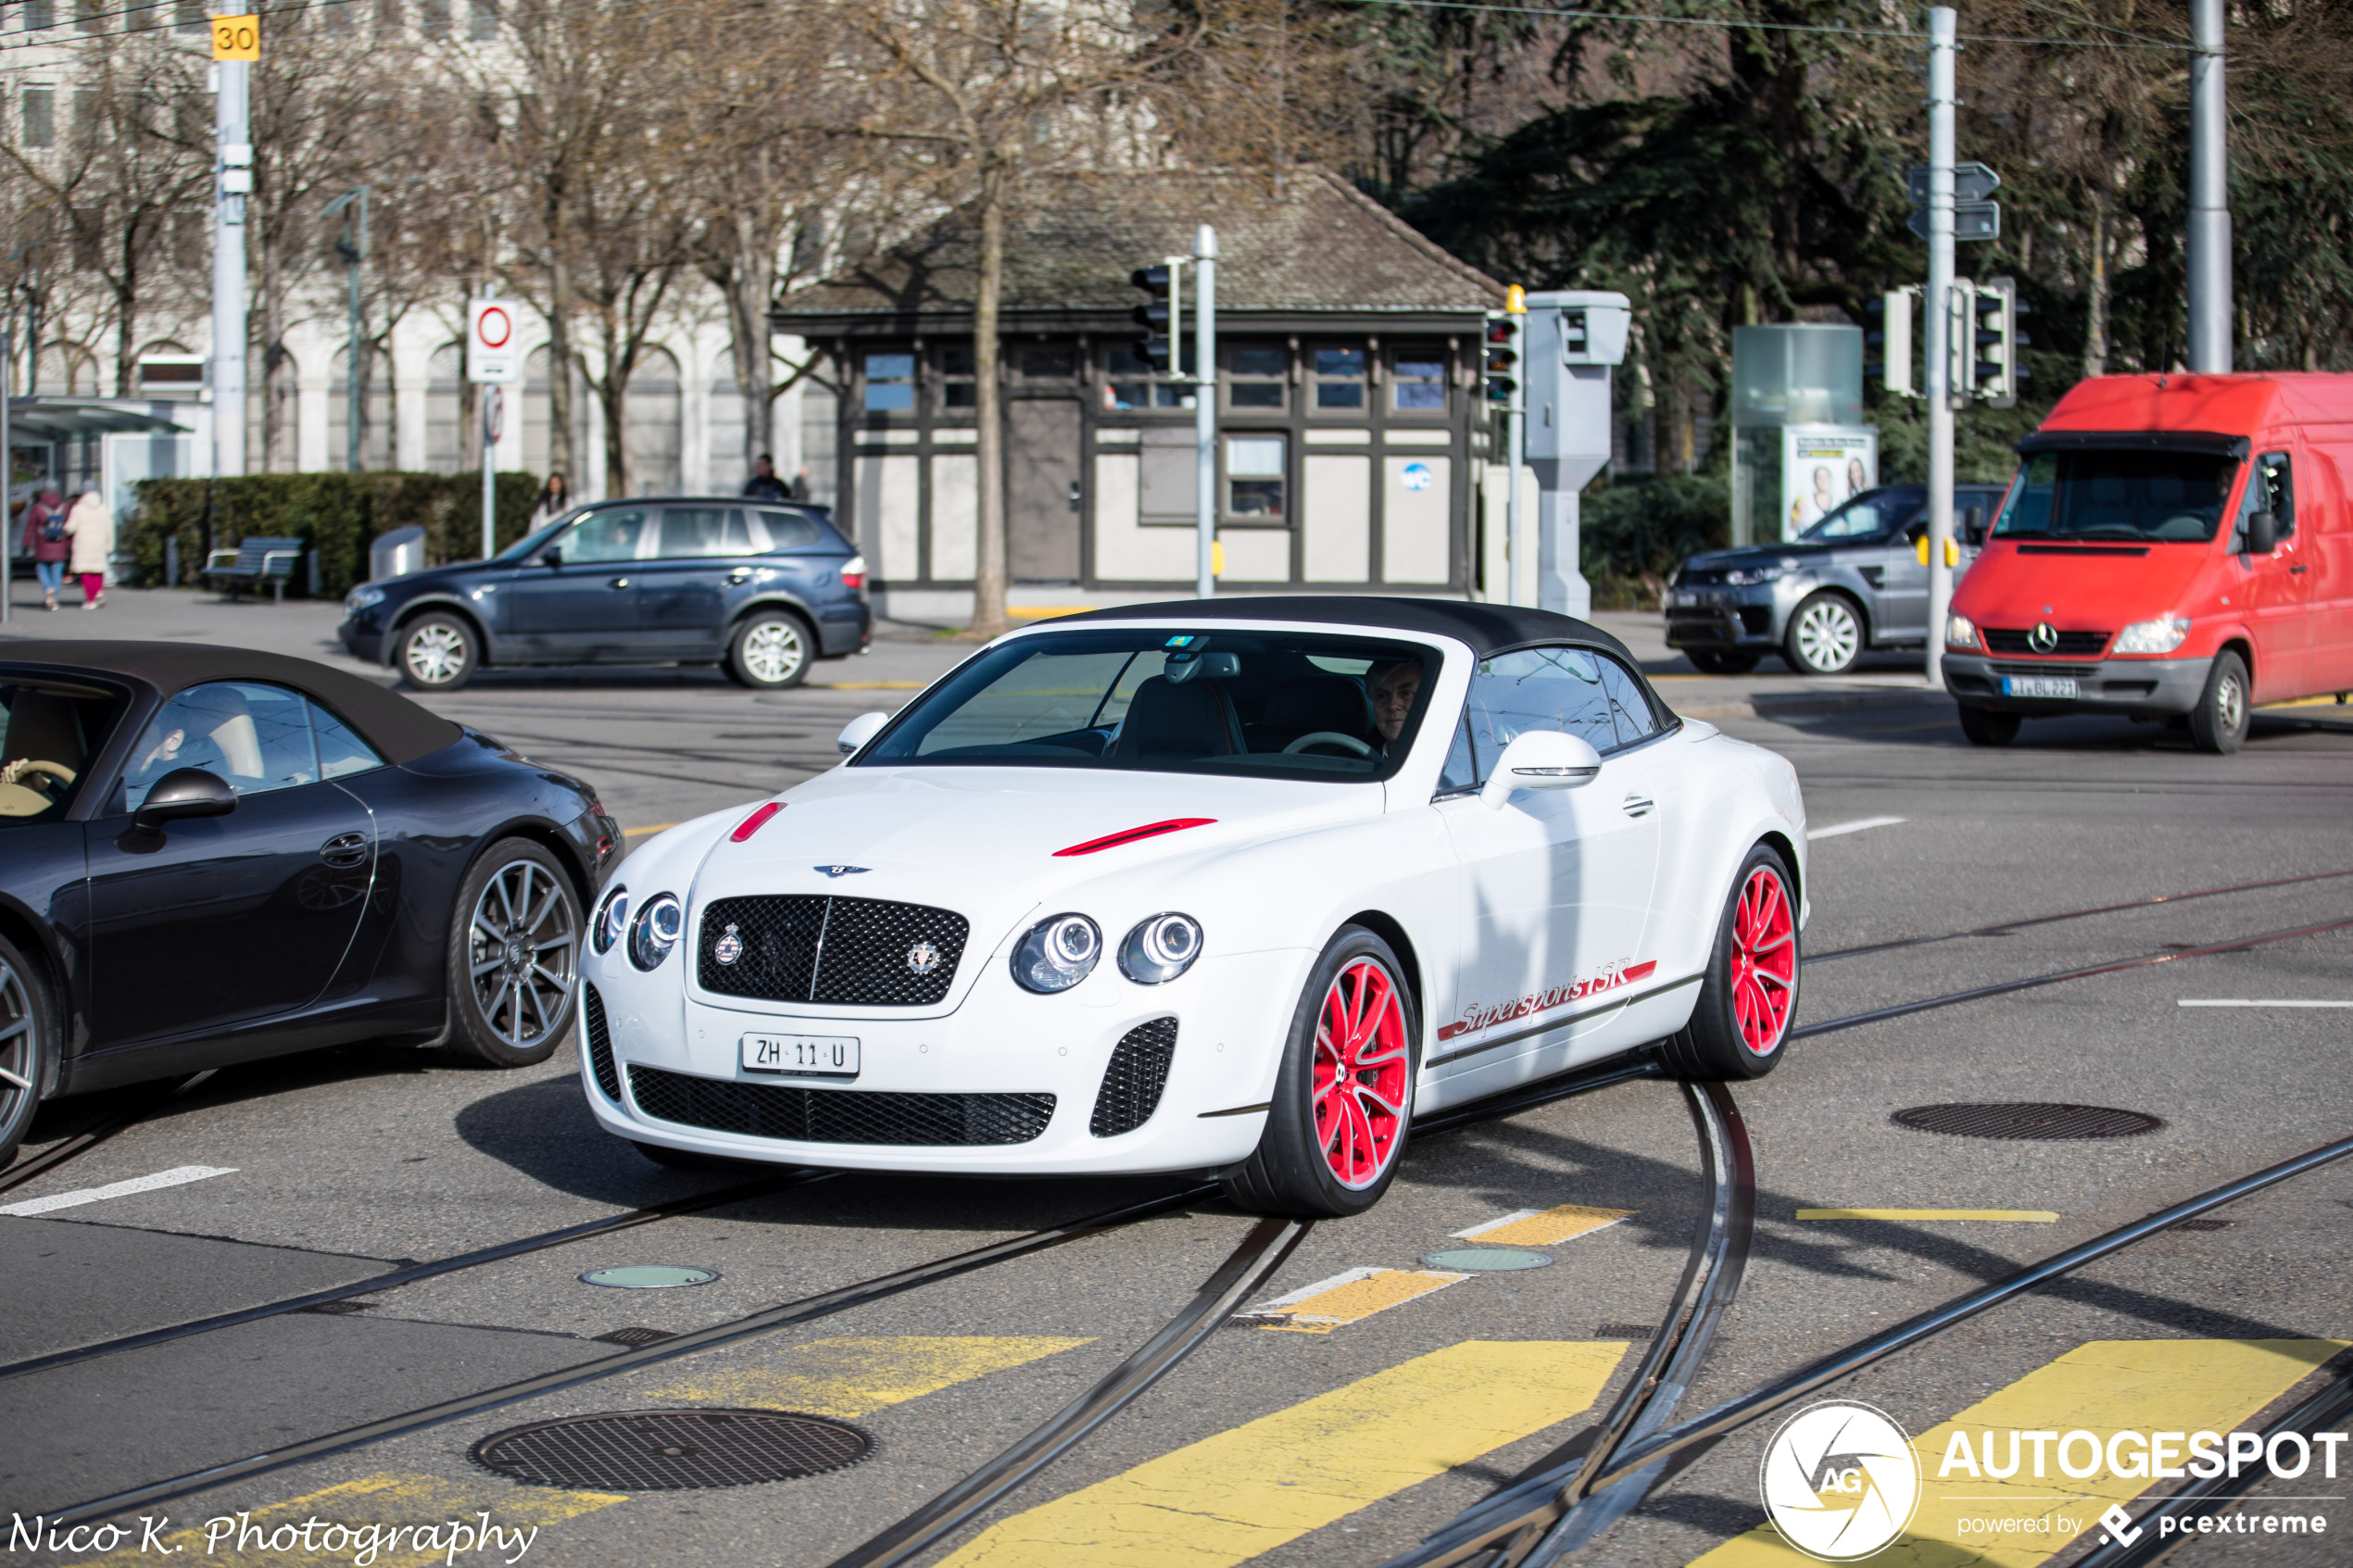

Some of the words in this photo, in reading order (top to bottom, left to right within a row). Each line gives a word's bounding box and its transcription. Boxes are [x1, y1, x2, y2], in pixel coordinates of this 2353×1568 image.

[217, 27, 253, 51] 30
[1401, 470, 1432, 490] WC
[1453, 975, 1585, 1039] Supersports
[757, 1039, 780, 1065] ZH
[796, 1042, 817, 1066] 11
[833, 1043, 844, 1067] U
